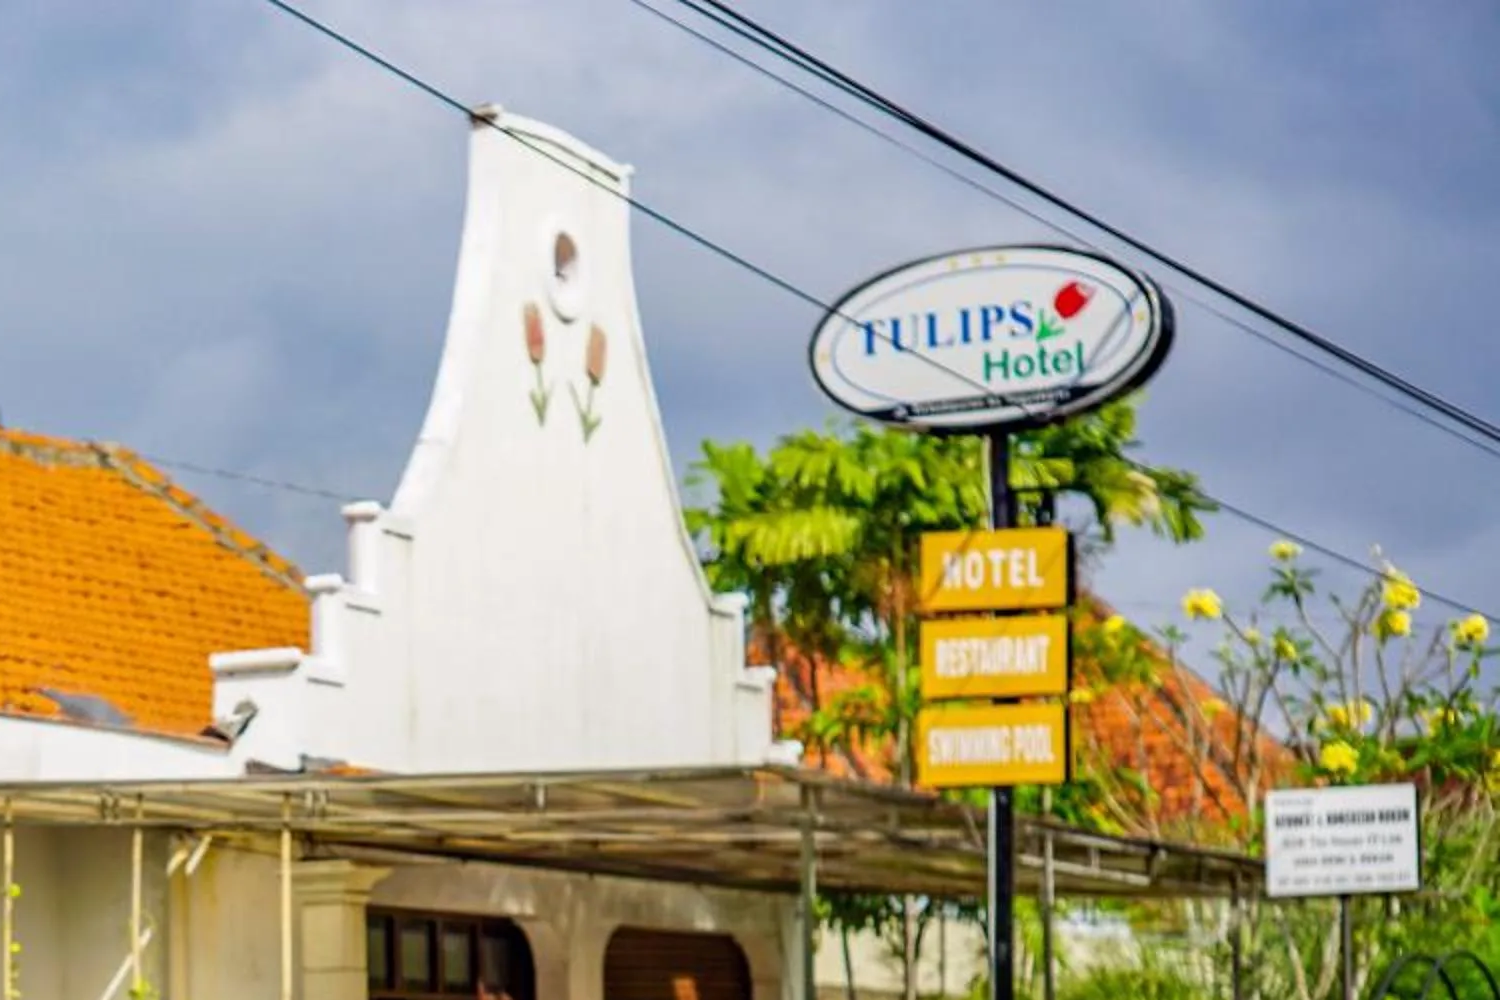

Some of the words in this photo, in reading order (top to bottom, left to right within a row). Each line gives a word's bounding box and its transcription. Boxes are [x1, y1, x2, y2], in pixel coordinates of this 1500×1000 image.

[862, 302, 1035, 355] TULIPS
[985, 342, 1084, 383] Hotel
[943, 547, 1044, 590] HOTEL
[935, 635, 1050, 678] RESTAURANT
